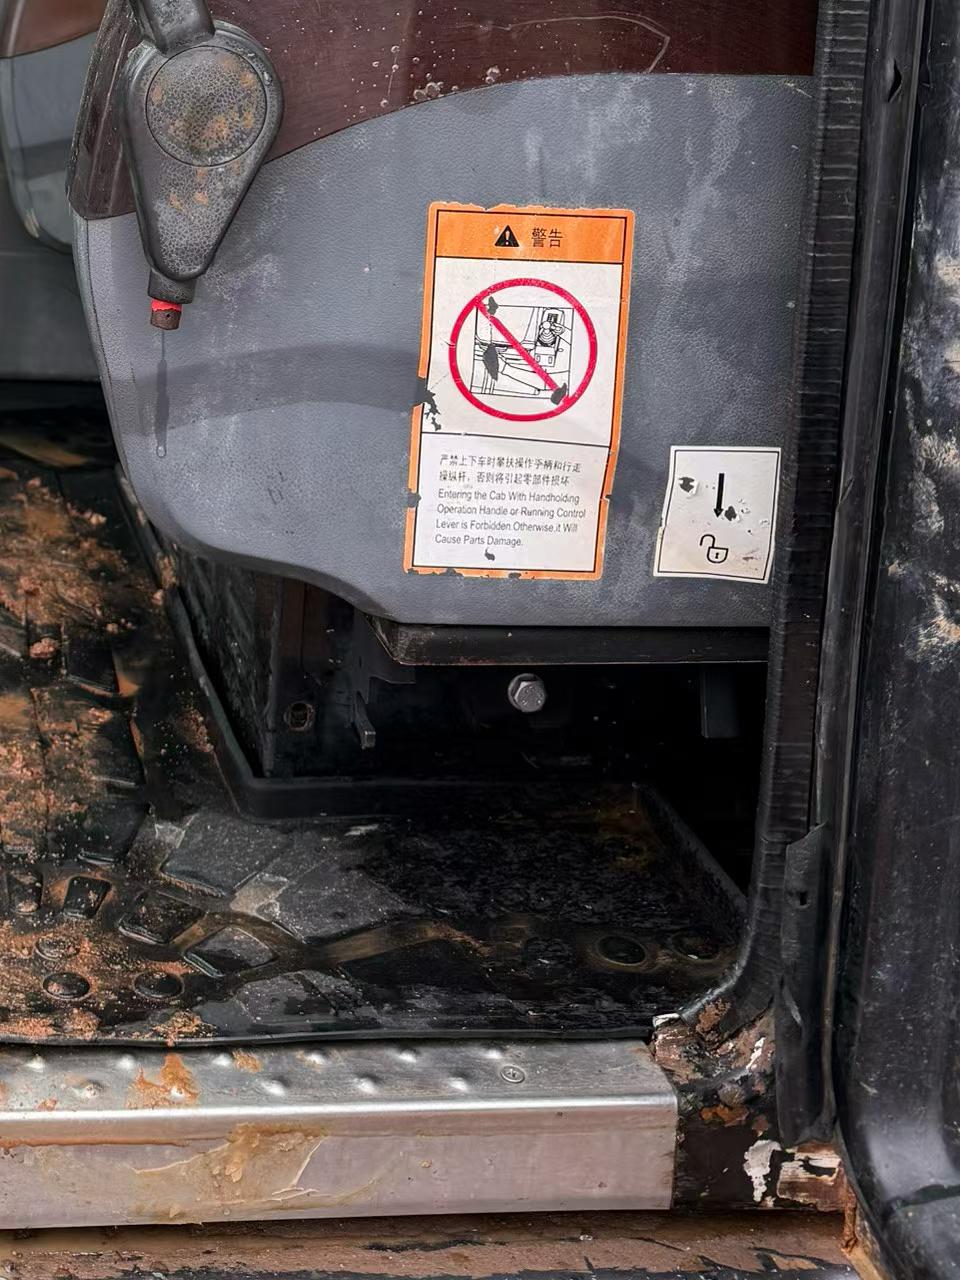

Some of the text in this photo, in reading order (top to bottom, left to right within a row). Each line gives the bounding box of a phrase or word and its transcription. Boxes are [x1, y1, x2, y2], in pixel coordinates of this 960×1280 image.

[531, 227, 563, 248] 警告
[438, 488, 580, 505] Entering the Cab With Handholding
[437, 503, 586, 519] Operation Handle or Running Control
[435, 519, 459, 529] Lever
[461, 521, 468, 529] is
[562, 523, 578, 533] Will
[435, 533, 524, 548] Cause Parts Damage.
